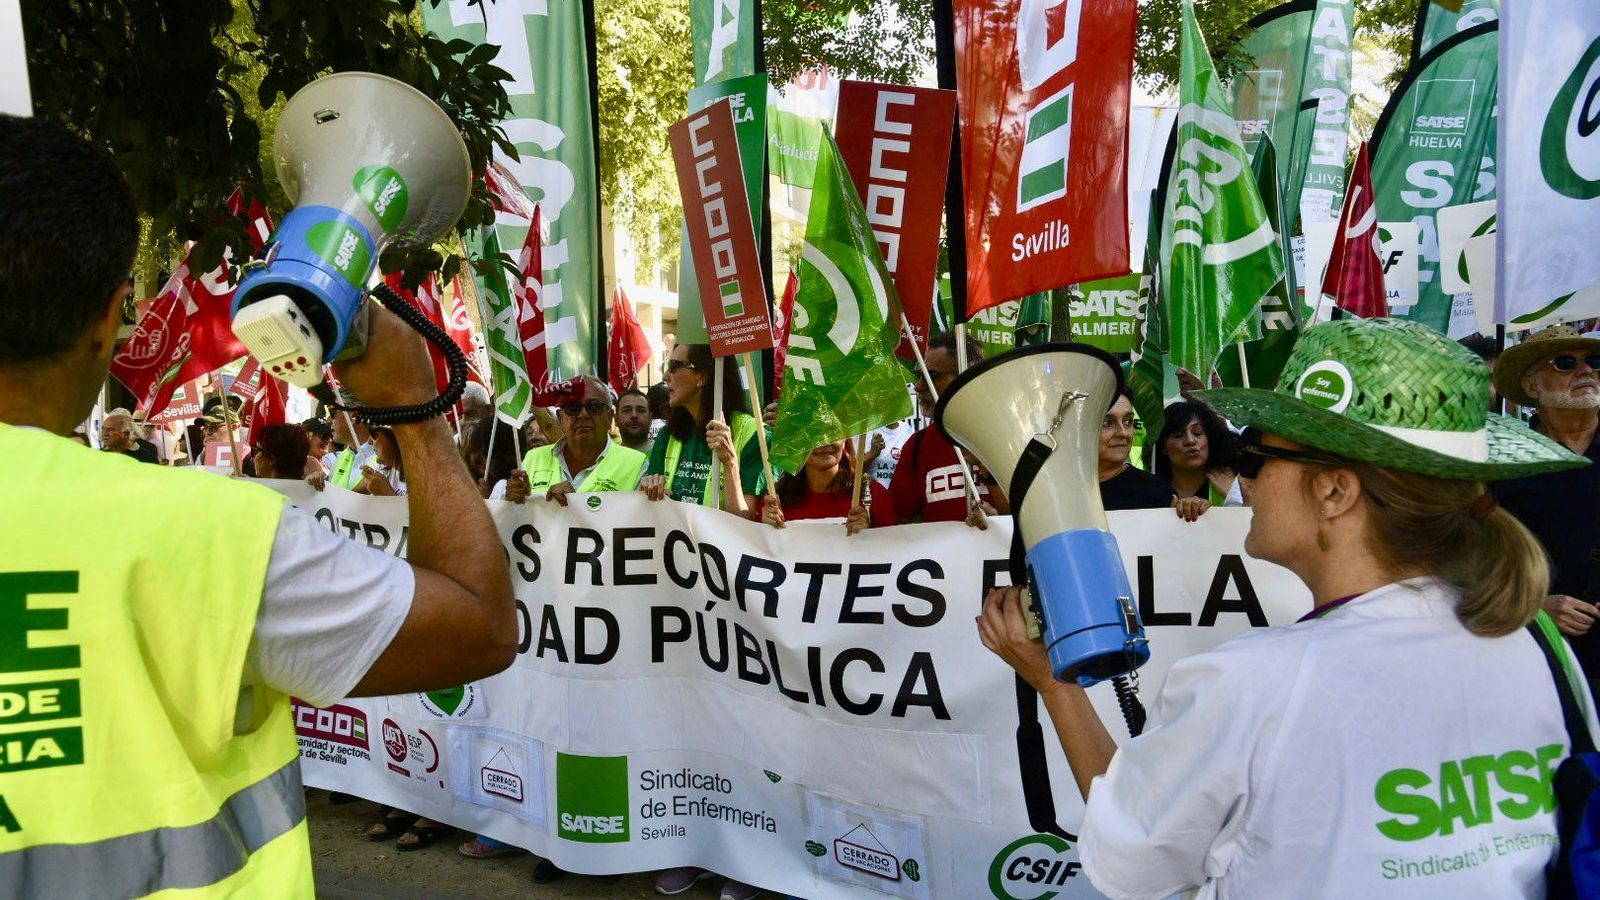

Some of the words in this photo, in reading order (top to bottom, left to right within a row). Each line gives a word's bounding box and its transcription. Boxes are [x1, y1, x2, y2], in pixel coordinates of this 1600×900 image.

[1415, 117, 1465, 128] SATSE
[1409, 136, 1462, 149] HUELVA
[375, 176, 401, 217] SATSE
[688, 115, 737, 279] CCOO
[335, 229, 359, 272] SATSE
[1012, 220, 1069, 262] Sevilla
[1303, 387, 1340, 401] enfermera
[1316, 378, 1331, 388] Soy
[163, 403, 200, 419] Sevilla
[564, 527, 946, 627] RECORTES
[1137, 554, 1270, 628] LA
[651, 601, 951, 720] PÚBLICA
[291, 705, 352, 736] COO
[296, 738, 328, 751] anidad
[306, 749, 317, 758] de
[319, 750, 347, 766] Sevilla
[487, 773, 517, 788] CERRADO
[640, 769, 732, 795] Sindicato
[1374, 743, 1564, 842] SATSE
[561, 812, 625, 834] SATSE
[641, 797, 666, 819] de
[673, 796, 776, 834] Enfermería
[641, 824, 686, 840] Sevilla
[842, 847, 890, 867] CERRADO
[1382, 849, 1479, 880] Sindicato
[1006, 856, 1082, 886] CSIF
